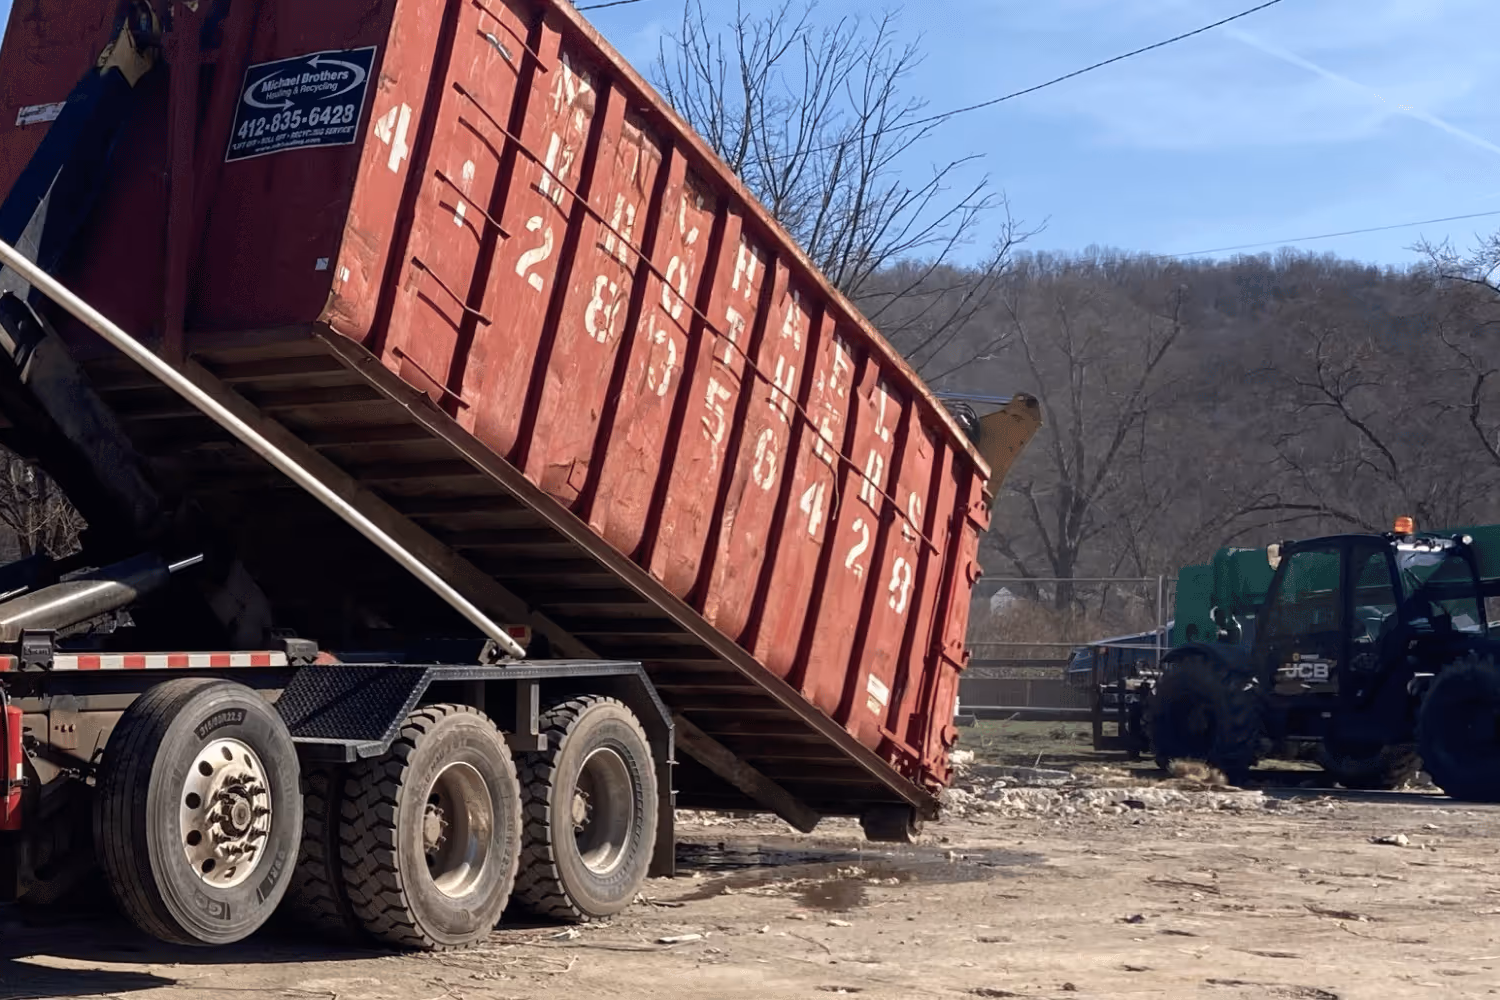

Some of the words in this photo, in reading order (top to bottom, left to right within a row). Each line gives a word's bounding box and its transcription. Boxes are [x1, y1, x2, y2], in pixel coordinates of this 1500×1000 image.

[261, 74, 301, 92] Michael
[301, 69, 350, 84] Brothers
[266, 88, 292, 101] Hauling
[300, 82, 339, 95] Recycling
[1284, 662, 1329, 678] JCB
